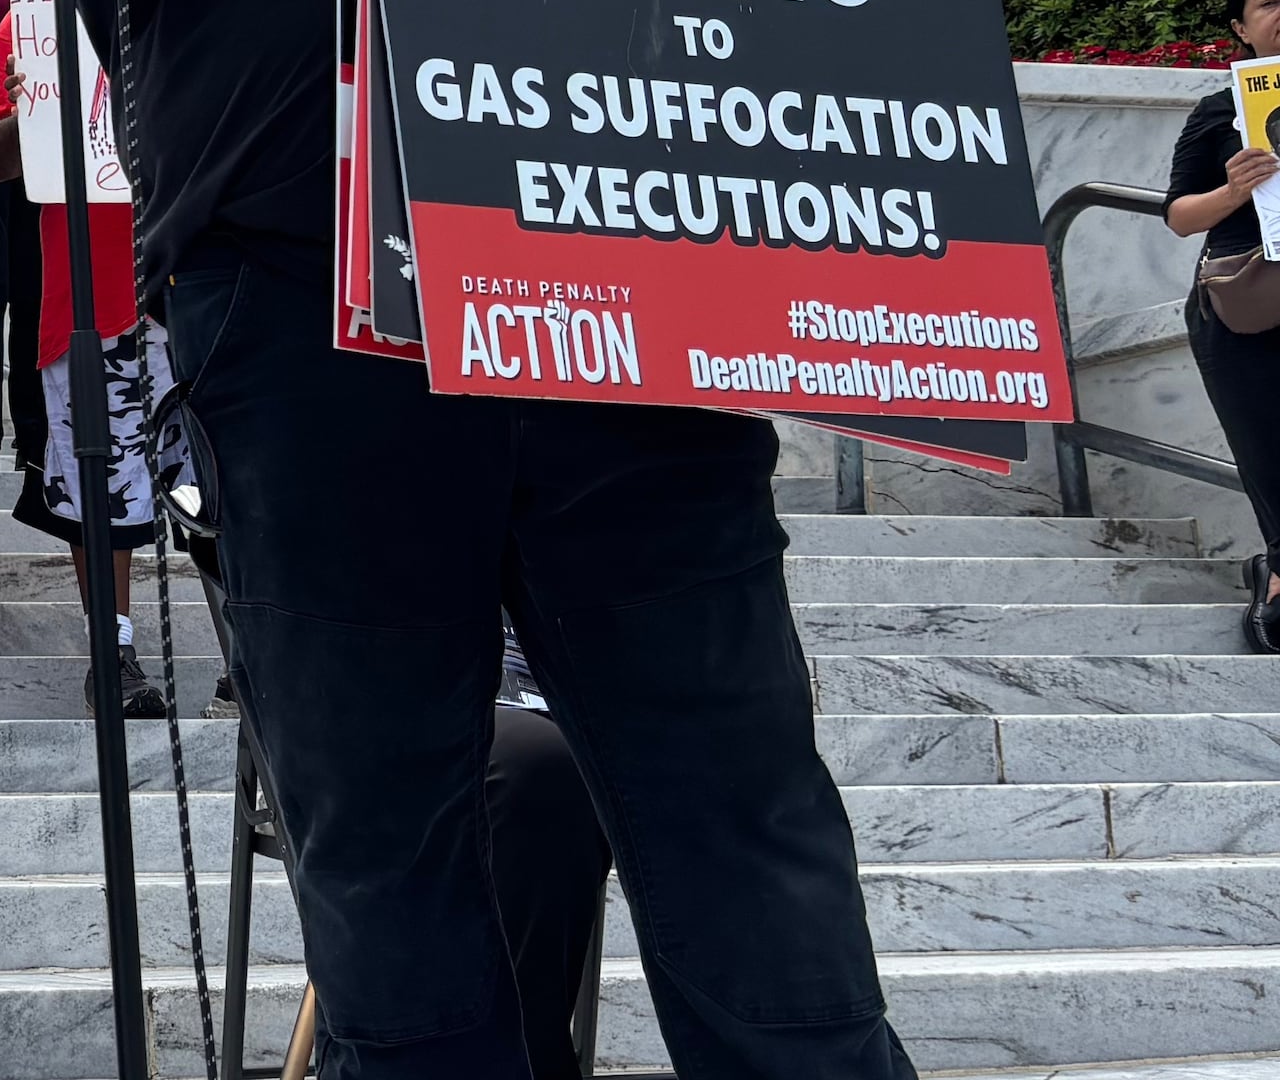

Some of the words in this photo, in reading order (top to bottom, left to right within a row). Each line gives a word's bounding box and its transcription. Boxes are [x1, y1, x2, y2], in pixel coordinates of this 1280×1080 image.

[674, 15, 735, 60] TO
[415, 57, 549, 131] GAS
[567, 71, 1009, 166] SUFFOCATION
[1245, 75, 1269, 93] THE
[515, 159, 940, 252] EXECUTIONS!
[462, 275, 530, 298] DEATH
[540, 281, 632, 304] PENALTY
[461, 301, 642, 386] ACTION
[788, 300, 1039, 352] #StopExecutions
[688, 350, 1050, 409] DeathPenaltyAction.org
